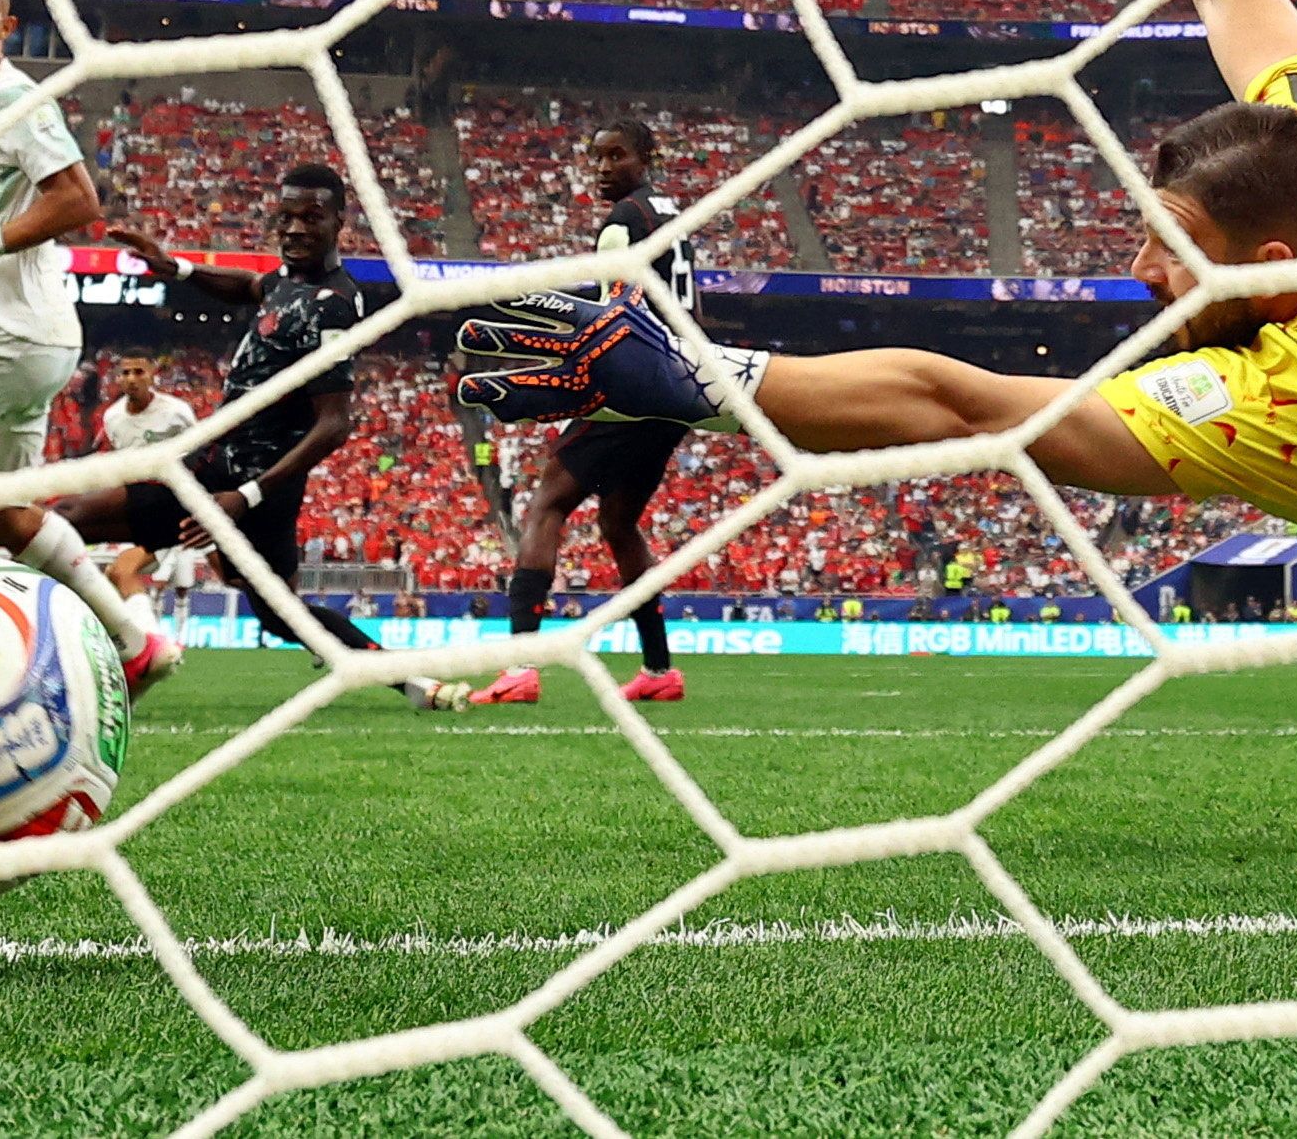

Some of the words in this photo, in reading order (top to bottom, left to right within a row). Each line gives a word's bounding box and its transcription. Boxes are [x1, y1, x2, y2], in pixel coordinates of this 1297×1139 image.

[819, 277, 911, 295] HOUSTON
[593, 618, 782, 653] Hiense
[908, 624, 971, 653] RGB
